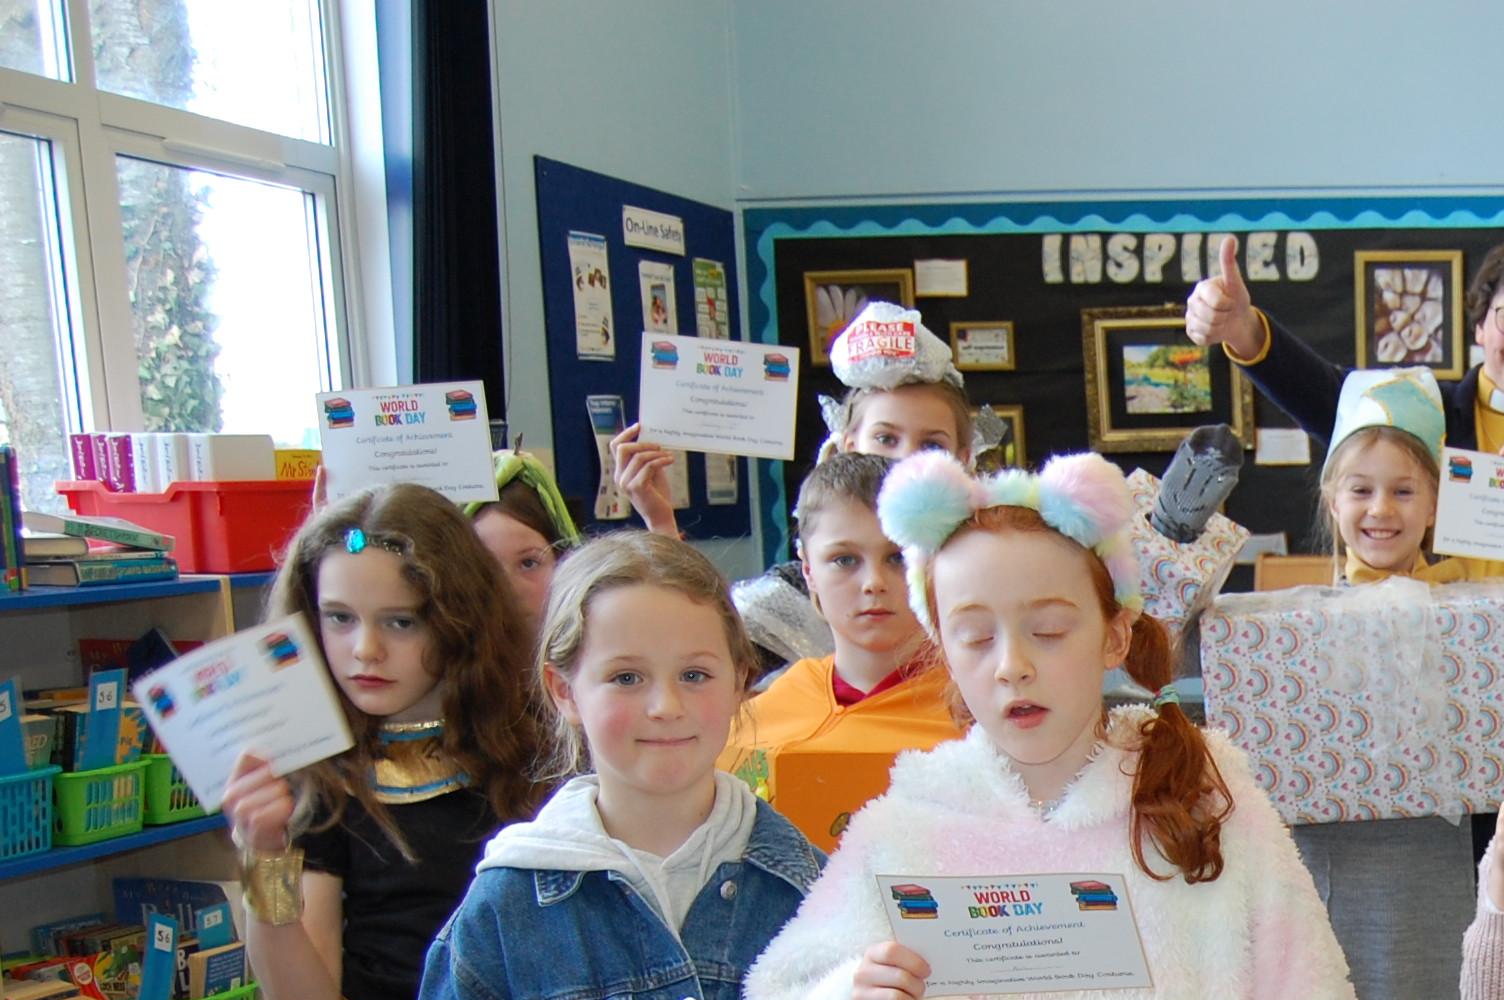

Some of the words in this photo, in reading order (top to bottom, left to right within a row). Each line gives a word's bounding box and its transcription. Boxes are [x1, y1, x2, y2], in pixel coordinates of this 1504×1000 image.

[660, 223, 681, 241] Safety
[848, 336, 913, 355] FRAGILE
[703, 352, 738, 366] WORLD
[696, 364, 721, 377] BOOK
[724, 366, 742, 379] DAY
[380, 400, 418, 413] WORLD
[374, 414, 402, 427] BOOK
[405, 412, 426, 425] DAY
[281, 462, 296, 478] Mr
[973, 889, 1031, 905] WORLD
[968, 903, 1010, 920] BOOK
[1014, 902, 1043, 917] DAY
[944, 927, 999, 938] Certificate
[1002, 925, 1012, 935] of
[1017, 921, 1085, 932] Achievement
[973, 937, 1063, 951] Congratulations!
